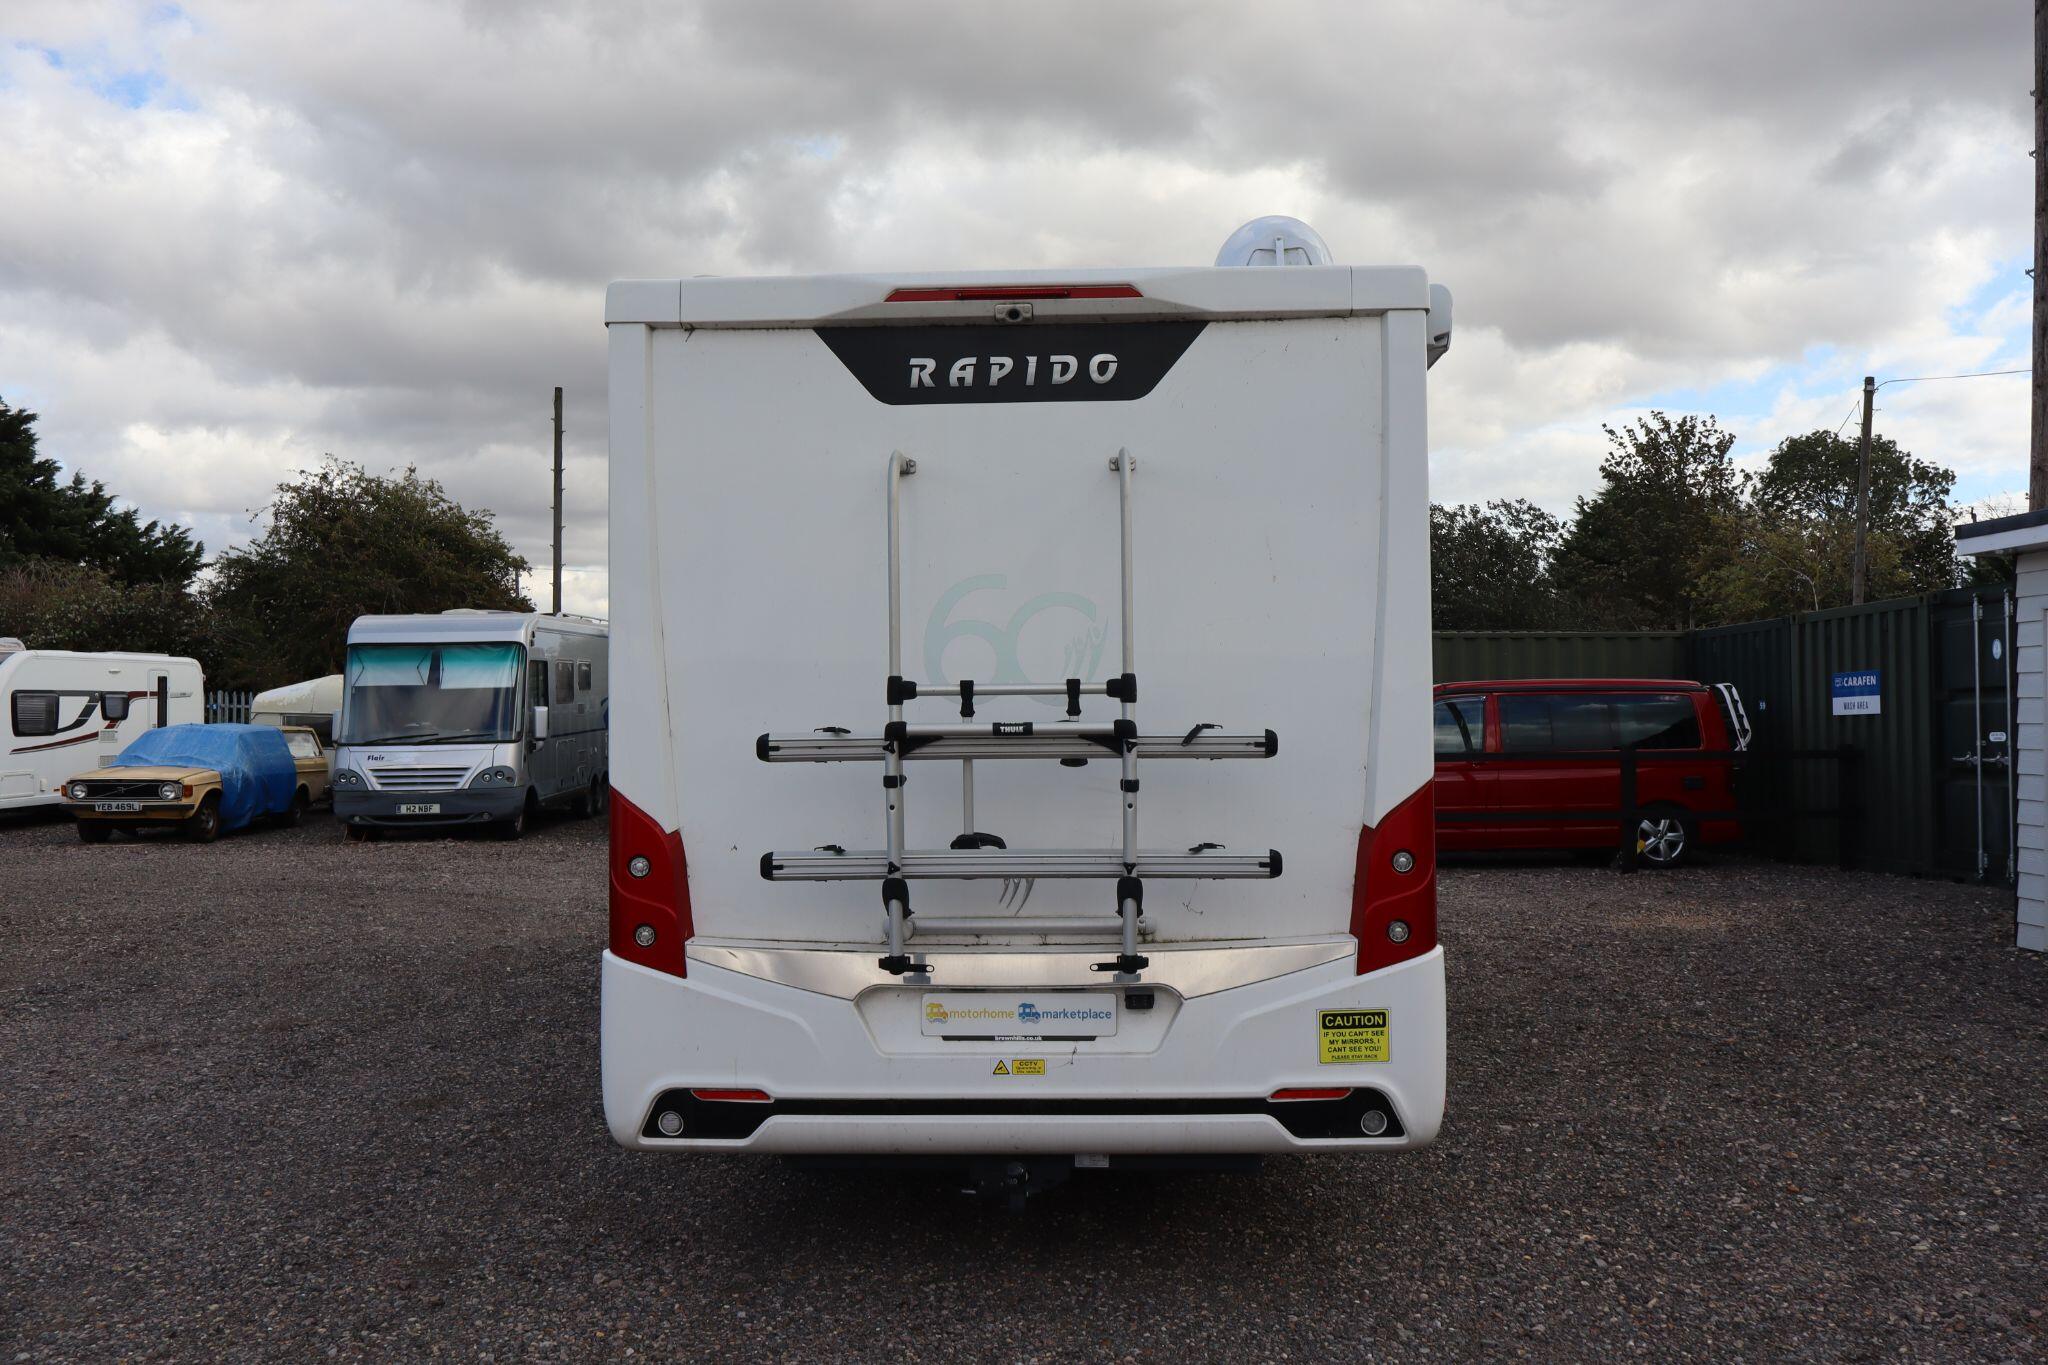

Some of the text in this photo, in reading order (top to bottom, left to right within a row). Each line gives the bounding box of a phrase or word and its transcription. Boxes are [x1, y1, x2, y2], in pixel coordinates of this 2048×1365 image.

[909, 353, 1118, 389] RAPIDO
[1843, 675, 1876, 686] CARAFEN
[1843, 700, 1869, 711] WASH AREA
[96, 803, 138, 811] YEB 469L
[405, 805, 433, 813] H2 NBF
[949, 1008, 1112, 1021] motorhome marketplace
[1325, 1015, 1383, 1027] CAUTION
